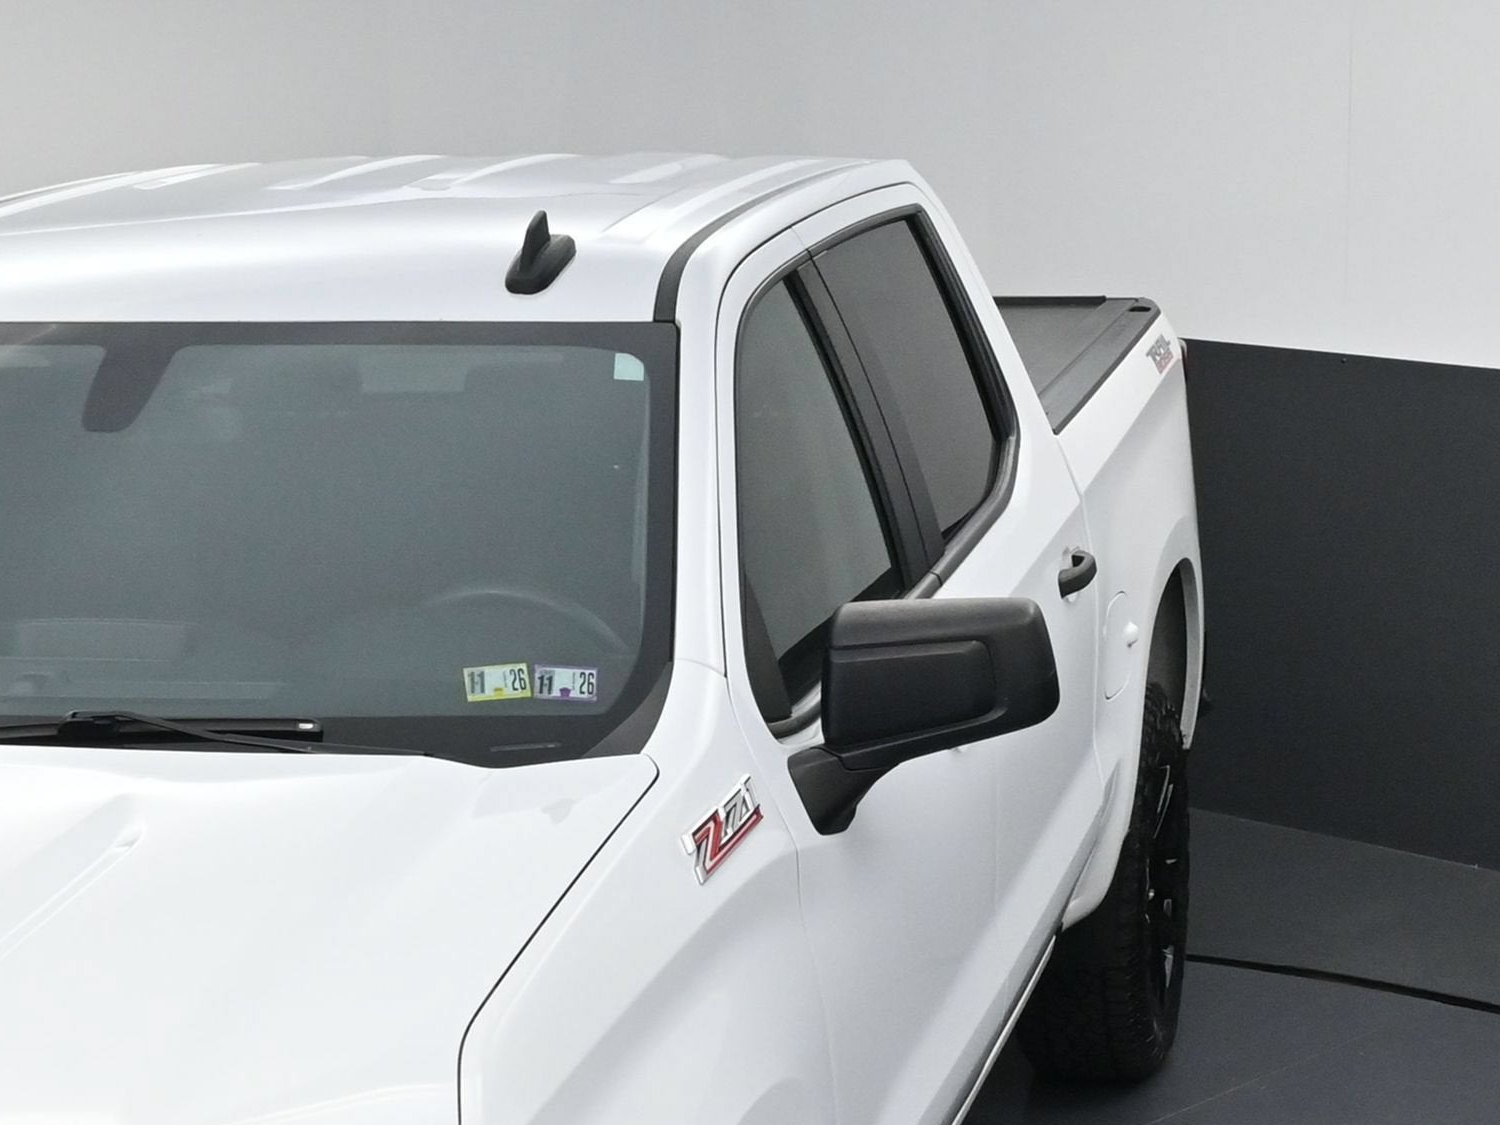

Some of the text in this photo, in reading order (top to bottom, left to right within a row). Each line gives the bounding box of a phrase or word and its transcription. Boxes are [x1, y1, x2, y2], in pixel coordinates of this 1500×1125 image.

[509, 668, 527, 691] 26
[537, 674, 554, 695] 11
[579, 672, 595, 695] 26
[681, 774, 764, 886] Z71
